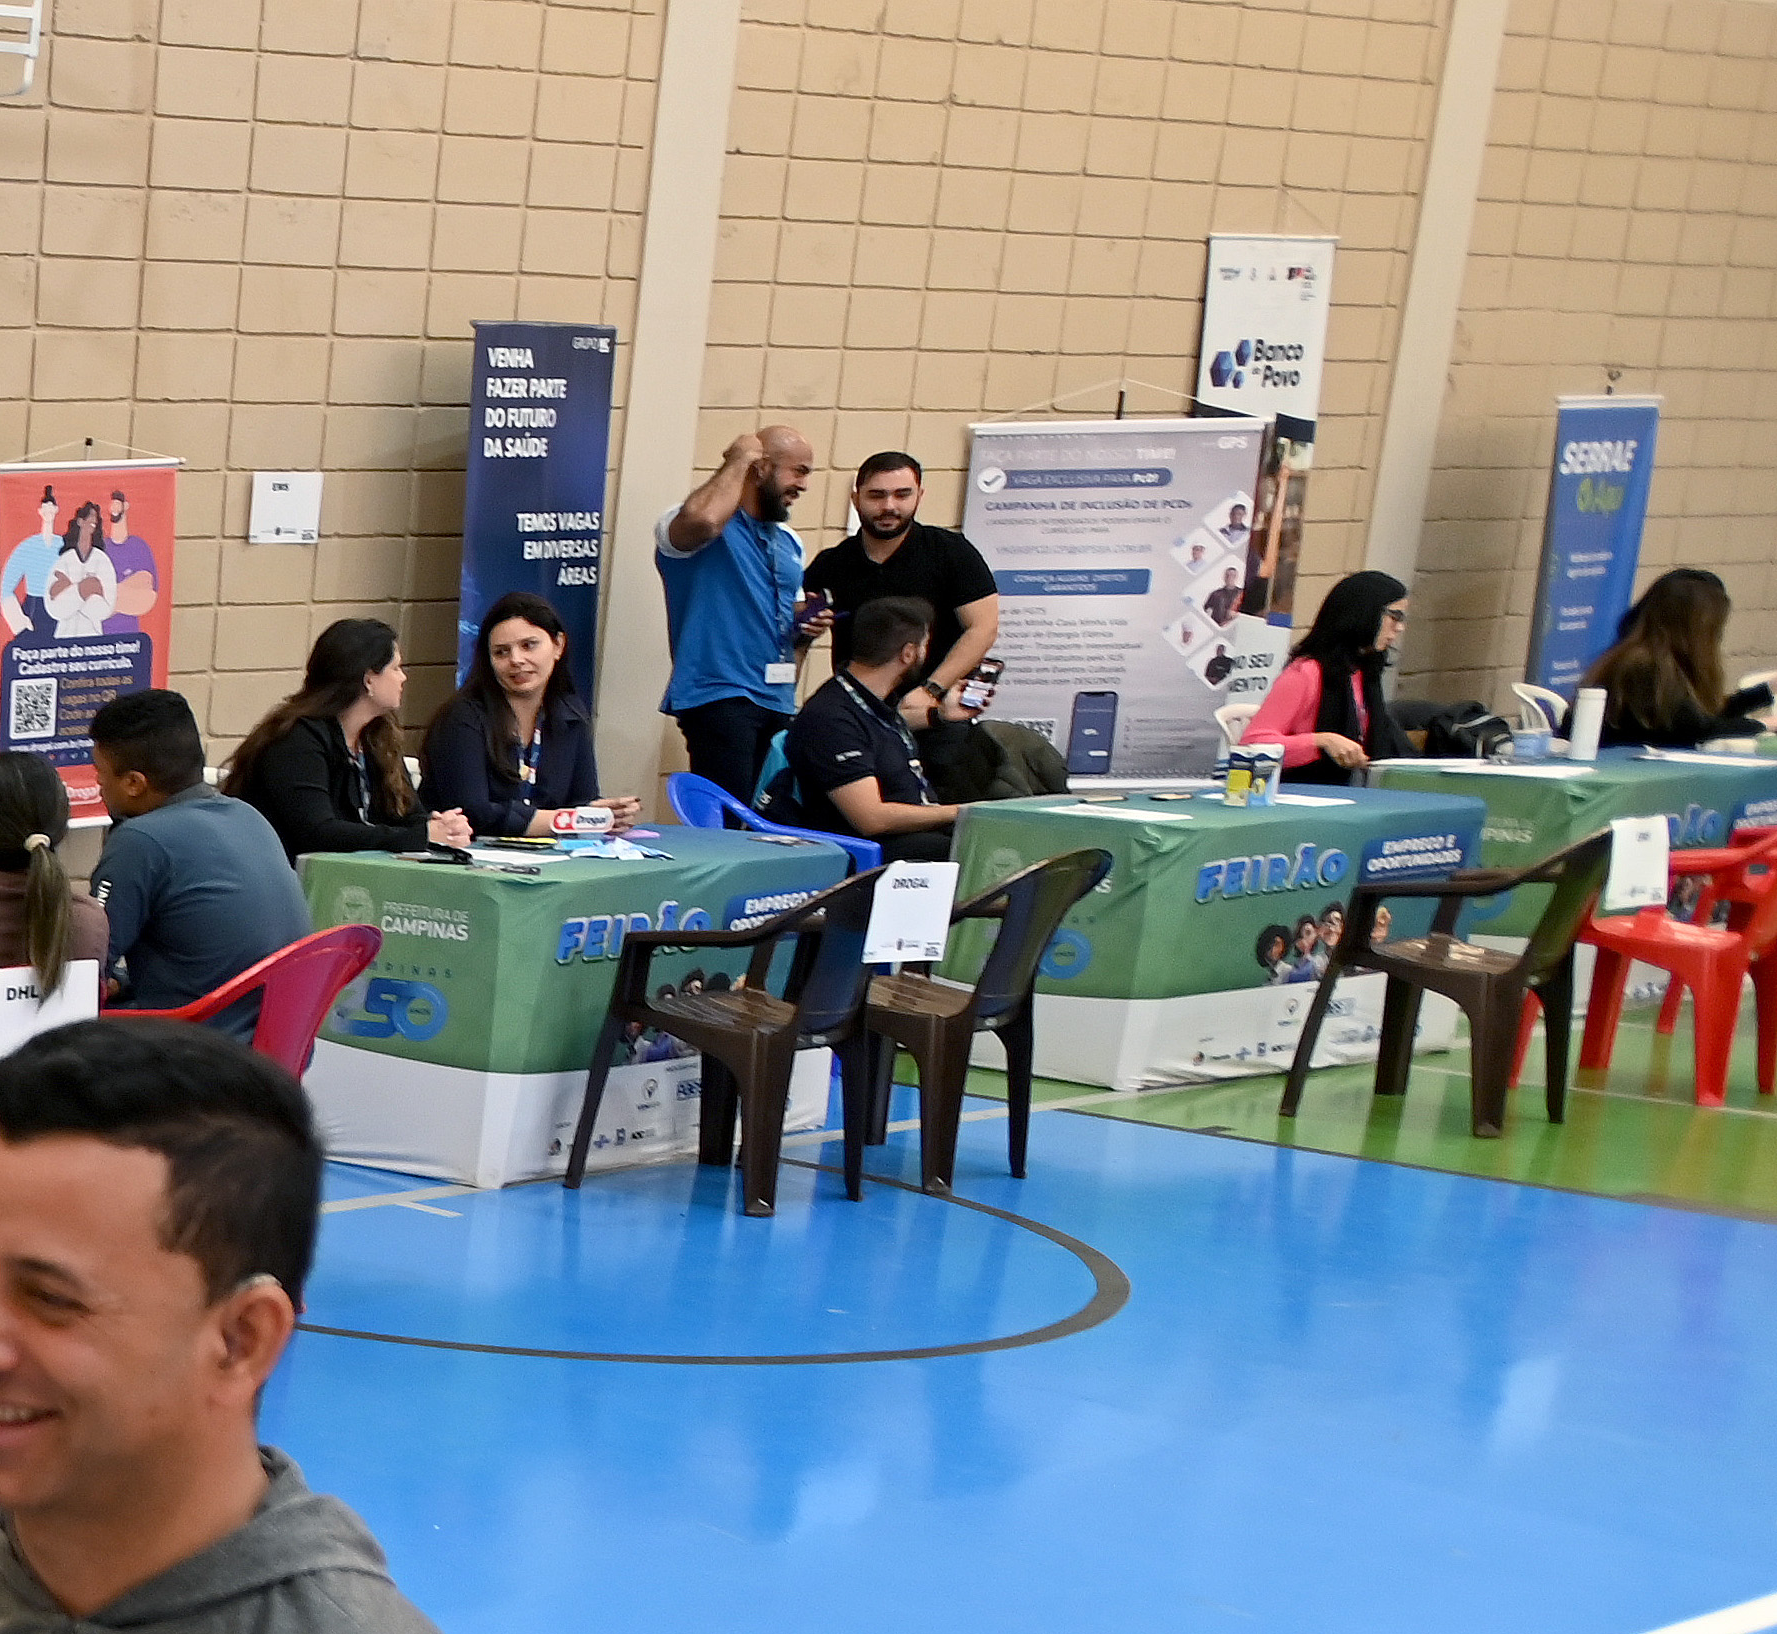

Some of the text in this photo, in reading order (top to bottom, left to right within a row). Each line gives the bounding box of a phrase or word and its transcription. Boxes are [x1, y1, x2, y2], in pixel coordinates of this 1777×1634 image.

[487, 347, 534, 369] VENHA
[1254, 339, 1304, 361] Banco
[1262, 365, 1301, 388] Povo
[486, 377, 567, 399] FAZER PARTE
[484, 408, 557, 428] DO FUTURO
[484, 432, 548, 458] DA SAÚDE
[1559, 439, 1638, 475] SEBRAE
[984, 499, 1057, 512] CAMPANHA
[1058, 499, 1077, 511] DE
[1142, 499, 1161, 510] DE
[516, 512, 600, 532] TEMOS VAGAS
[523, 540, 598, 560] EM DIVERSAS
[557, 561, 597, 586] ÁREAS
[70, 644, 84, 657] do
[84, 643, 115, 656] nosso
[1252, 653, 1274, 668] SEU
[69, 661, 88, 673] seu
[1195, 842, 1349, 904] FEIRÃO
[452, 909, 469, 924] DE
[380, 915, 469, 942] CAMPINAS
[6, 984, 39, 1001] DHL
